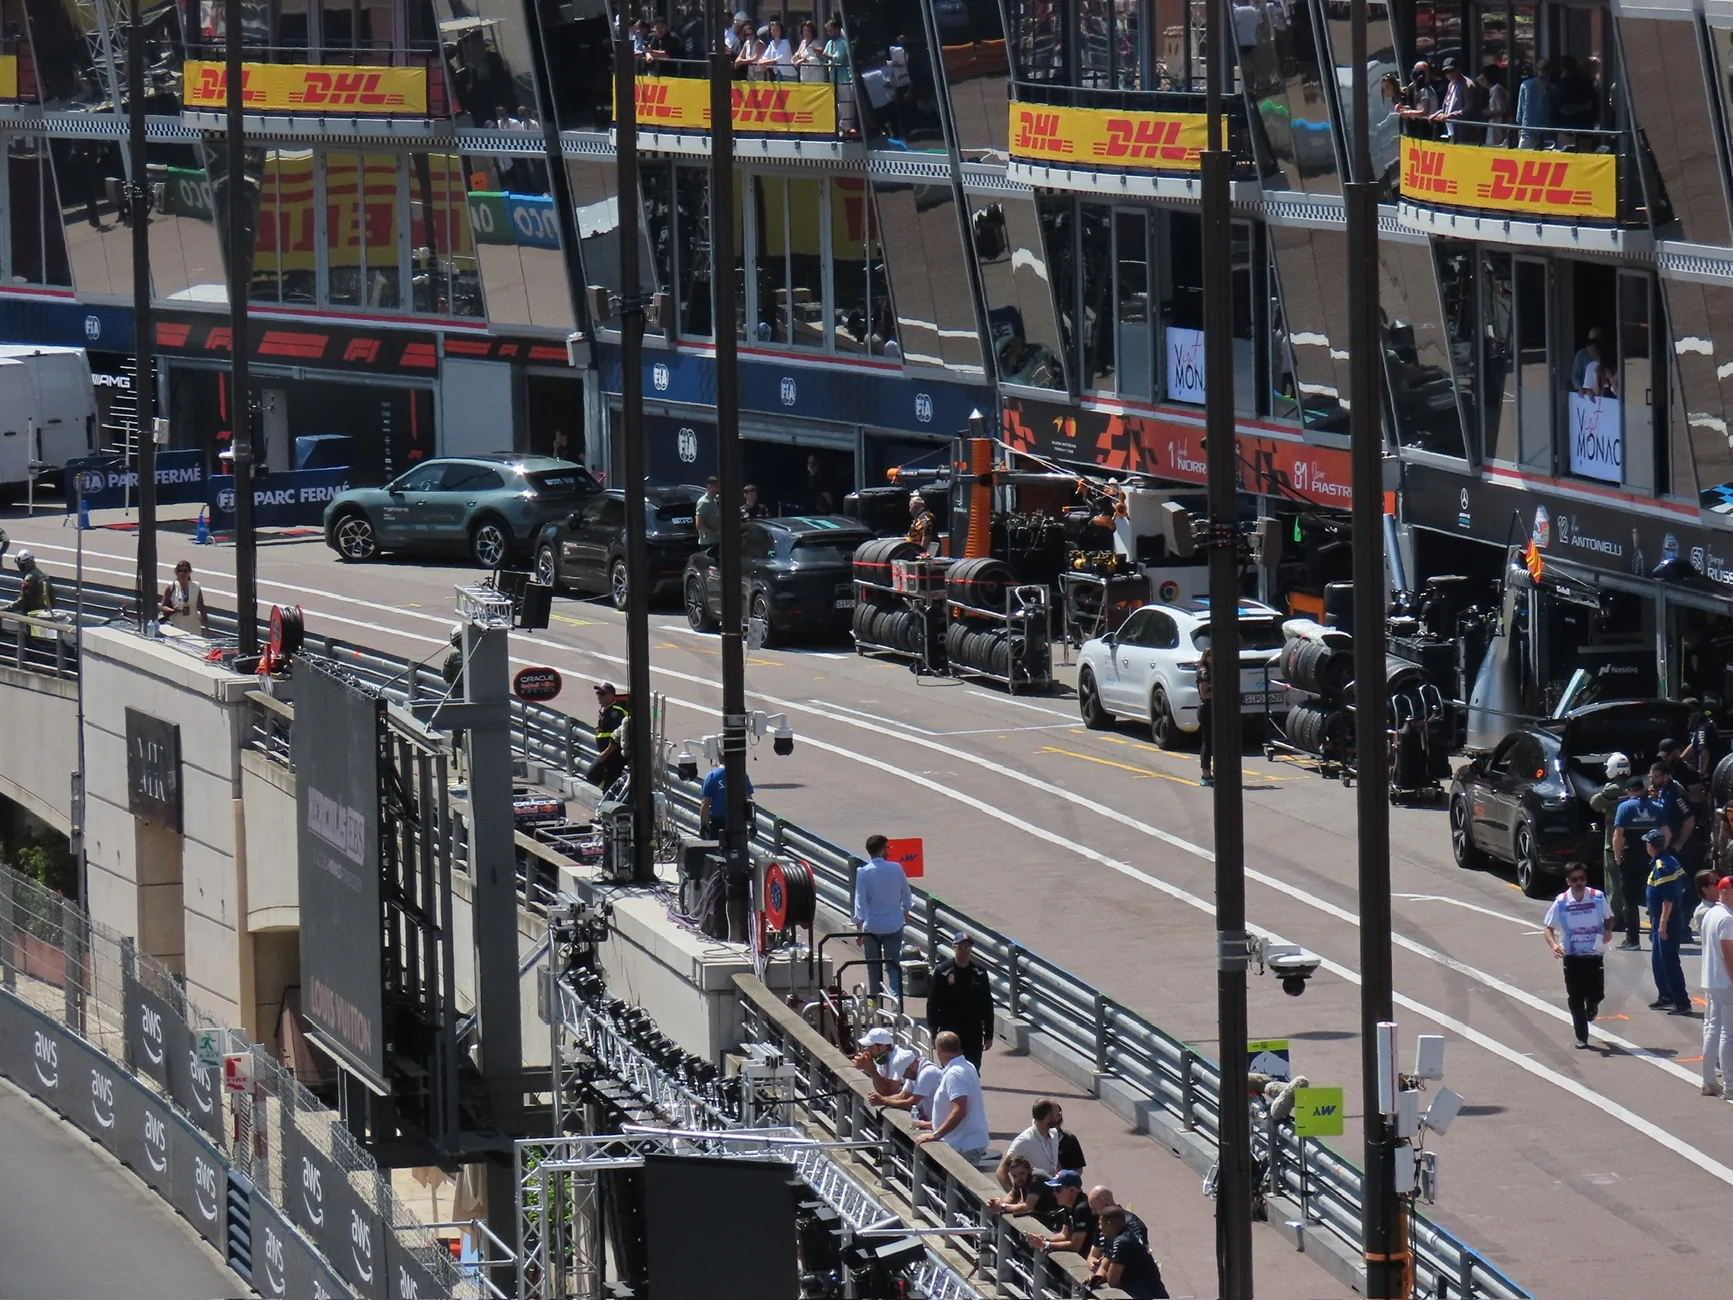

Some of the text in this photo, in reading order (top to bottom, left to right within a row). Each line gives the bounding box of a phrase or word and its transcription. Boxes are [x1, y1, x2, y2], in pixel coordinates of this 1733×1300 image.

[303, 72, 387, 105] DHL
[1020, 111, 1063, 153] DHL
[1106, 119, 1187, 160] DHL
[1408, 147, 1448, 194] DHL
[1491, 158, 1574, 205] DHL
[98, 374, 131, 389] AMG
[1175, 363, 1206, 396] MON
[1177, 457, 1208, 475] NORR
[1576, 431, 1621, 468] MONAC
[108, 469, 139, 488] PAR
[155, 463, 201, 485] FERMÉ
[1294, 461, 1308, 491] 81
[254, 488, 296, 506] PARC
[1556, 515, 1569, 544] 12
[1571, 535, 1622, 557] ANTONELLI
[1707, 567, 1733, 585] RUSS
[520, 674, 555, 683] ORACLE
[513, 799, 558, 807] ORACLE
[142, 1003, 162, 1044] aws
[34, 1030, 58, 1069] aws
[91, 1068, 113, 1107] aws
[145, 1110, 166, 1151] aws
[195, 1156, 216, 1199] aws
[302, 1156, 322, 1202] aws
[265, 1226, 284, 1273] aws
[352, 1208, 371, 1259] aws
